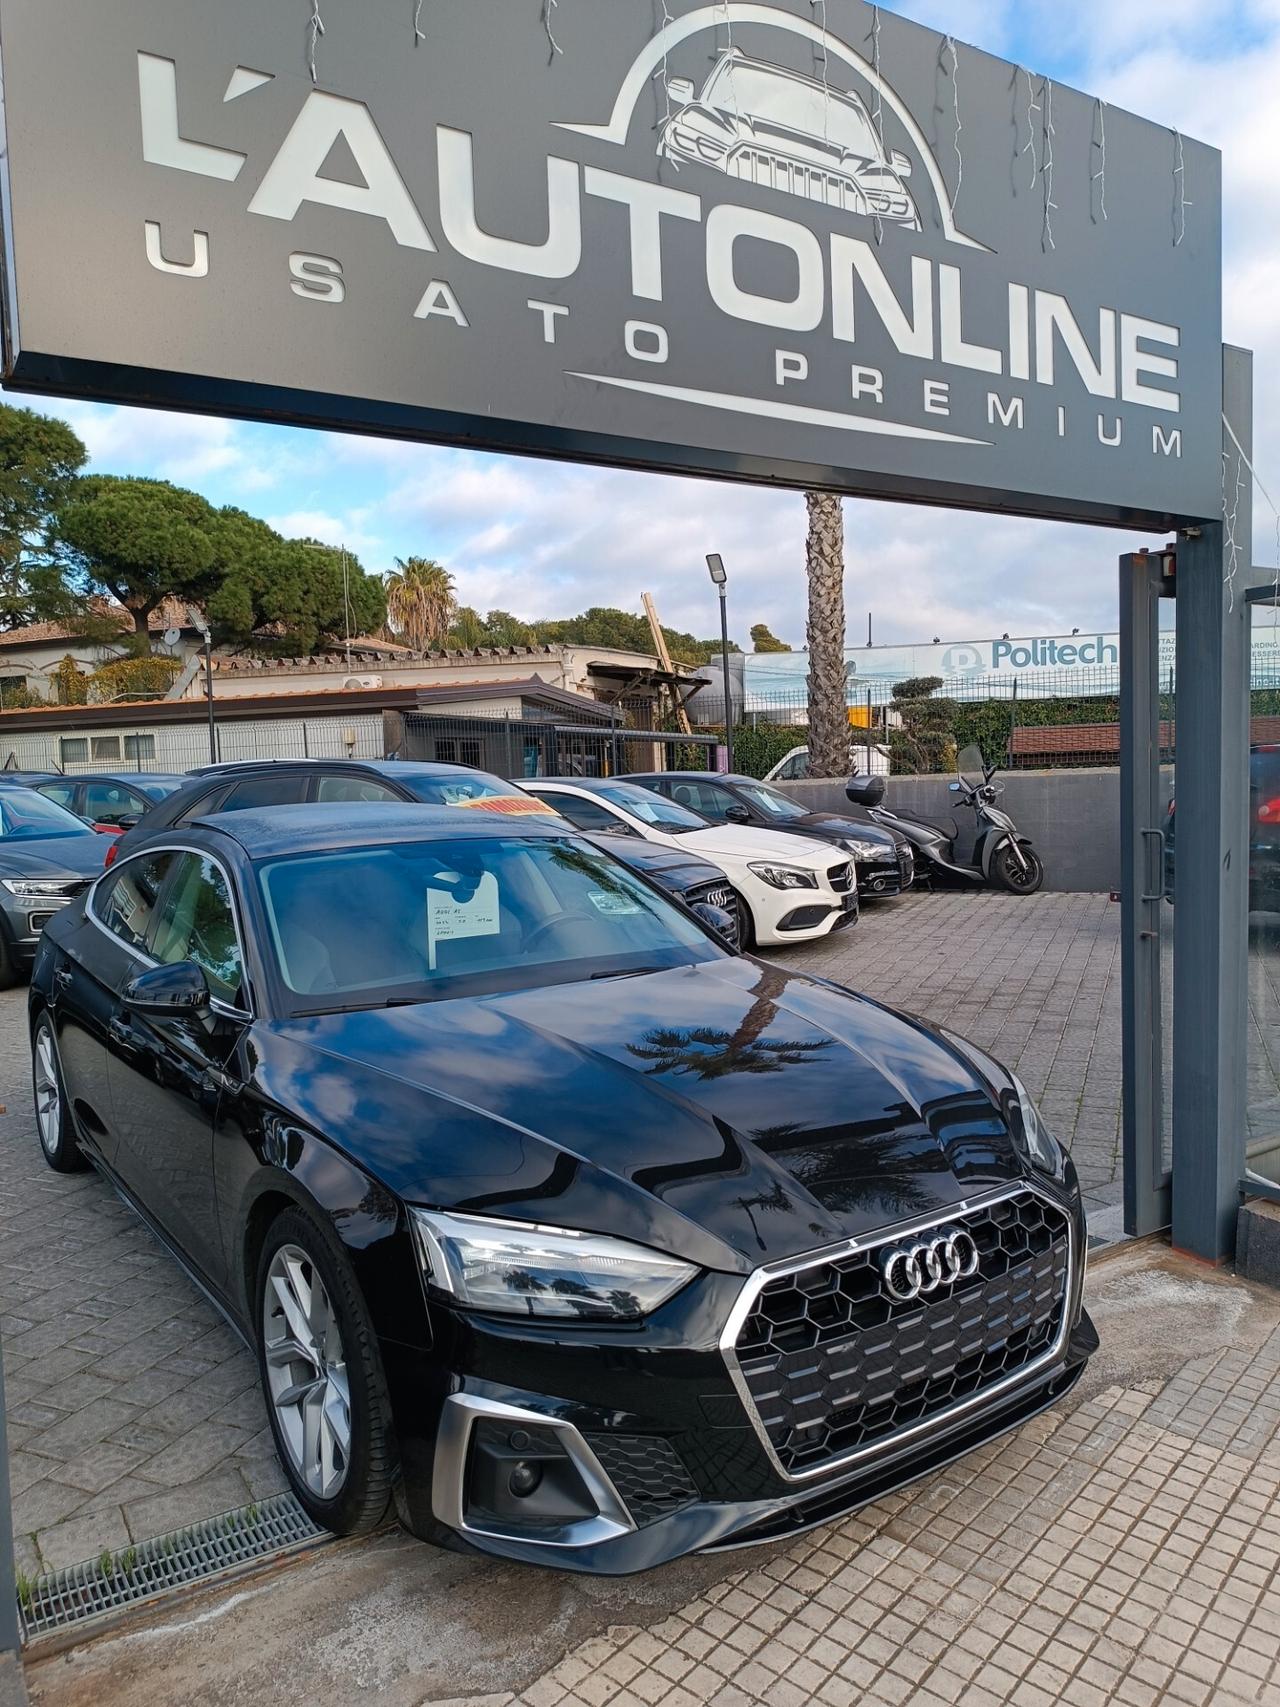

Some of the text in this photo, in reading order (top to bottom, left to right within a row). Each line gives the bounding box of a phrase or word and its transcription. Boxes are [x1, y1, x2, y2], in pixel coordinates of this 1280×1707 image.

[137, 50, 1181, 413] L'AUTONLINE
[144, 219, 1183, 459] USATO PREMIUM
[991, 636, 1118, 669] Politech
